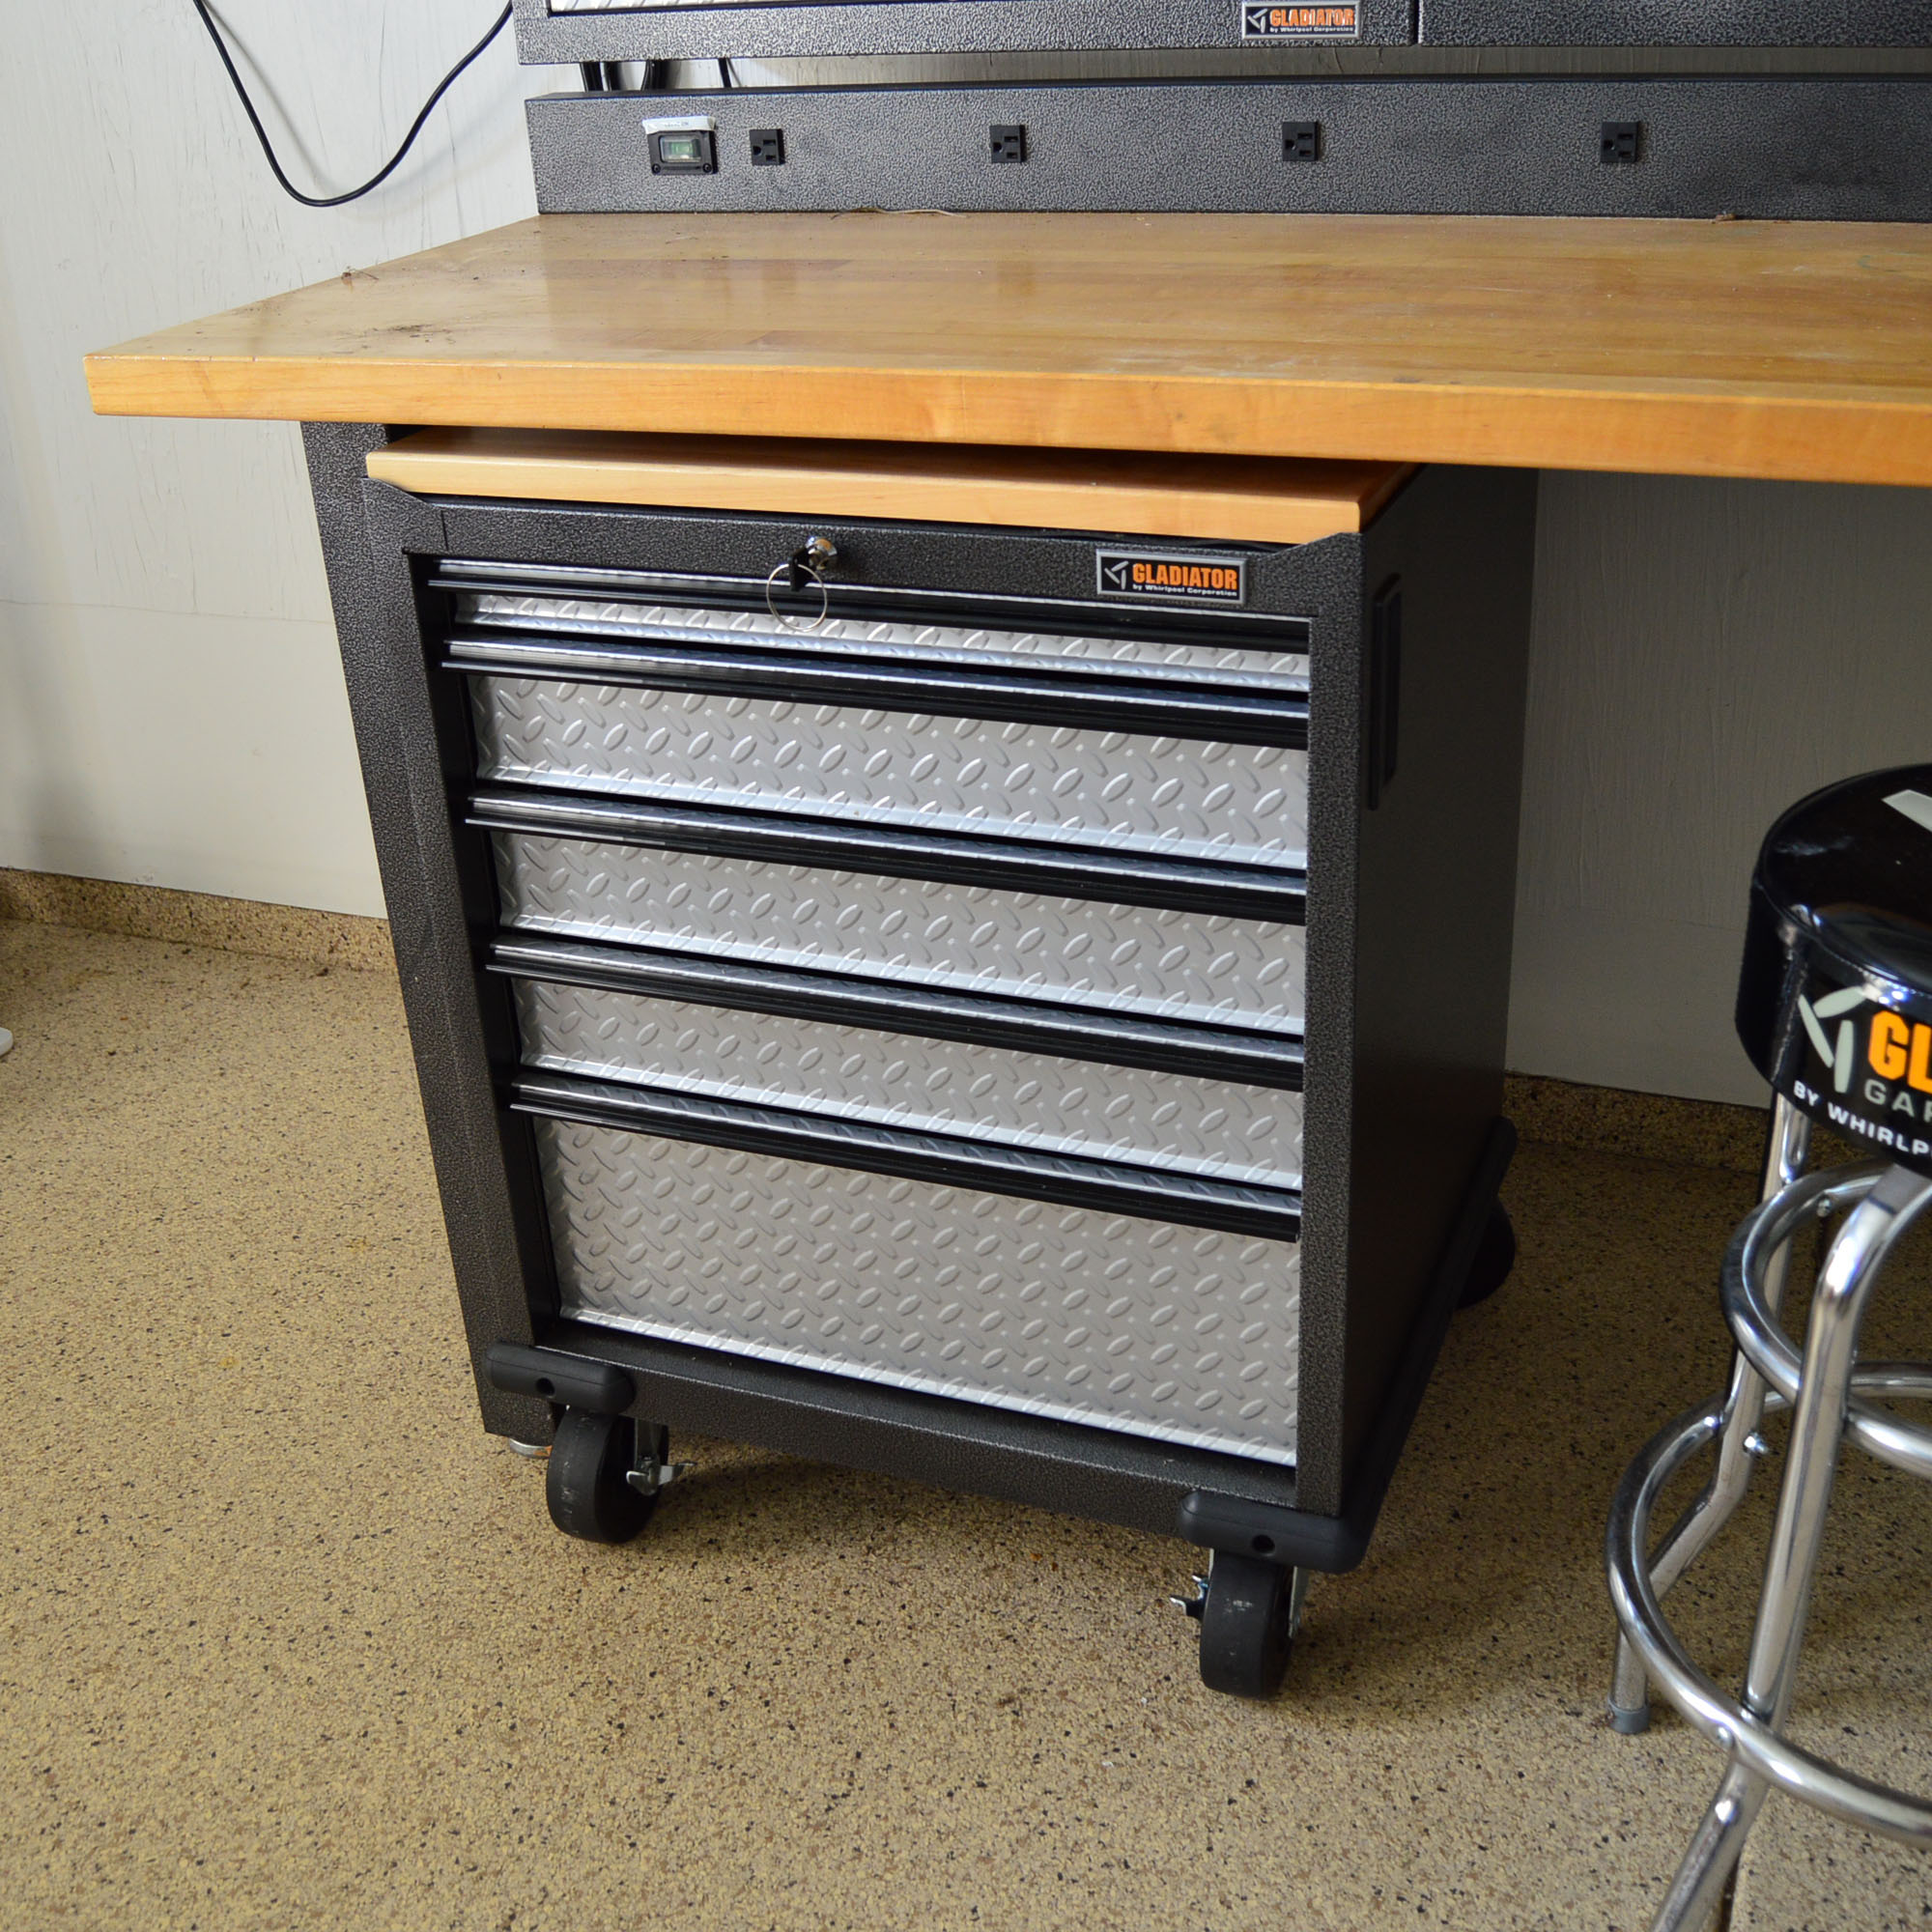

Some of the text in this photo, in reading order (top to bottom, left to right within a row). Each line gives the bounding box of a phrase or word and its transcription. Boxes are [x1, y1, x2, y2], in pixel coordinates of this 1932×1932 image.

[1269, 8, 1354, 27] GLADIATOR
[1132, 563, 1237, 590] GLADIATOR
[1146, 584, 1185, 593] Whirlpool
[1187, 587, 1237, 596] Corporation
[1793, 1080, 1932, 1156] BY WHIRLP
